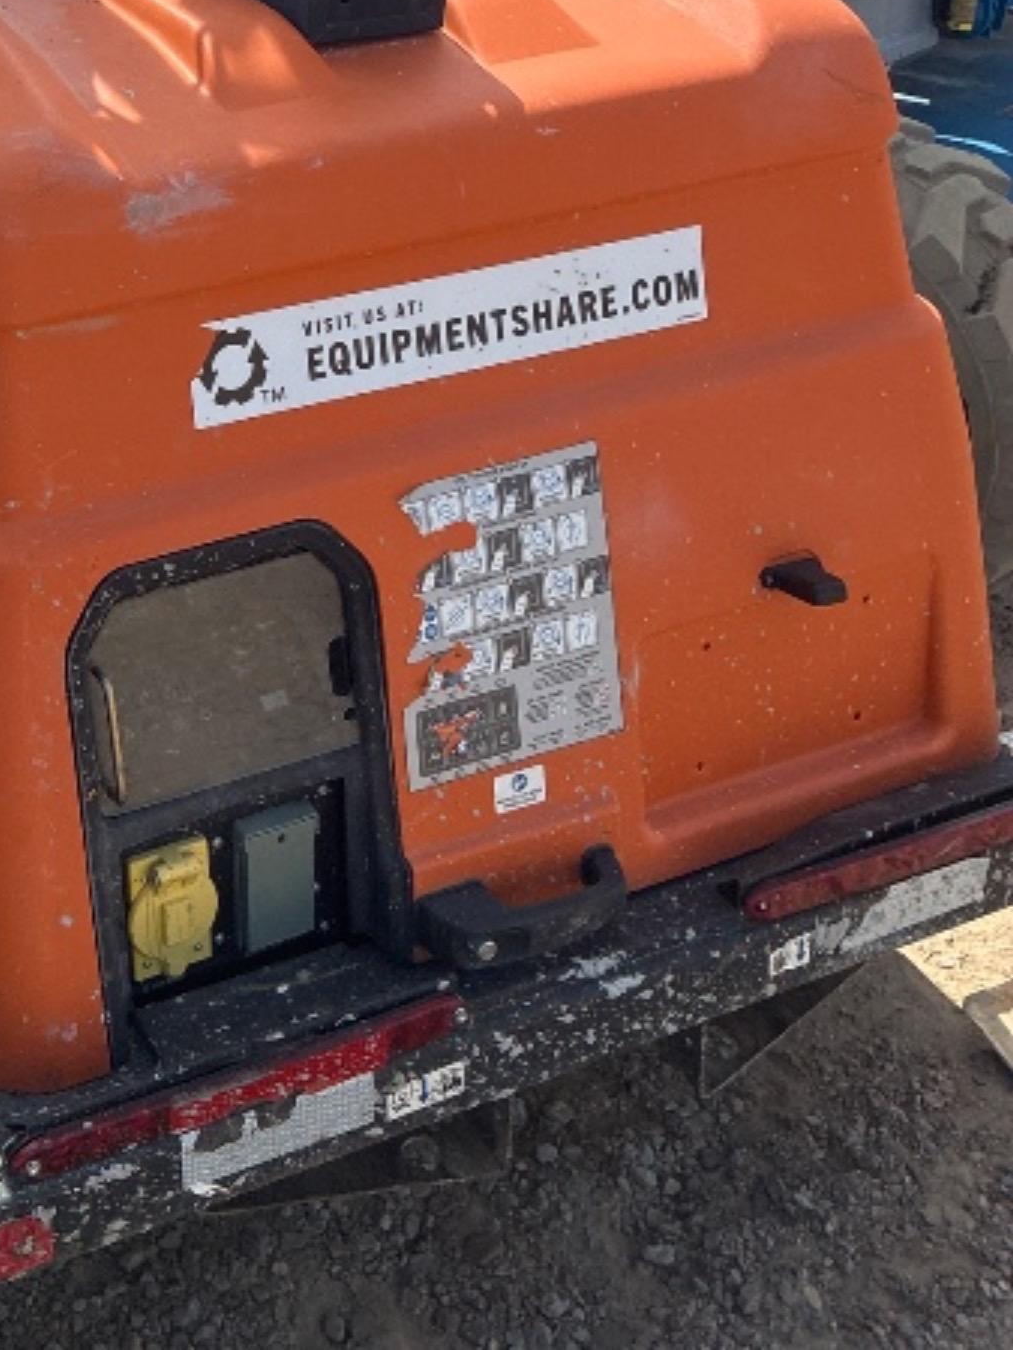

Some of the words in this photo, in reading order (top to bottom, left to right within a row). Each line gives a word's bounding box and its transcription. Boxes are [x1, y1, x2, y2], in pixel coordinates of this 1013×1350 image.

[302, 312, 353, 336] VISIT
[364, 306, 386, 325] US
[307, 268, 700, 381] EQUIPMENTSHARE.COM
[259, 386, 285, 403] TM
